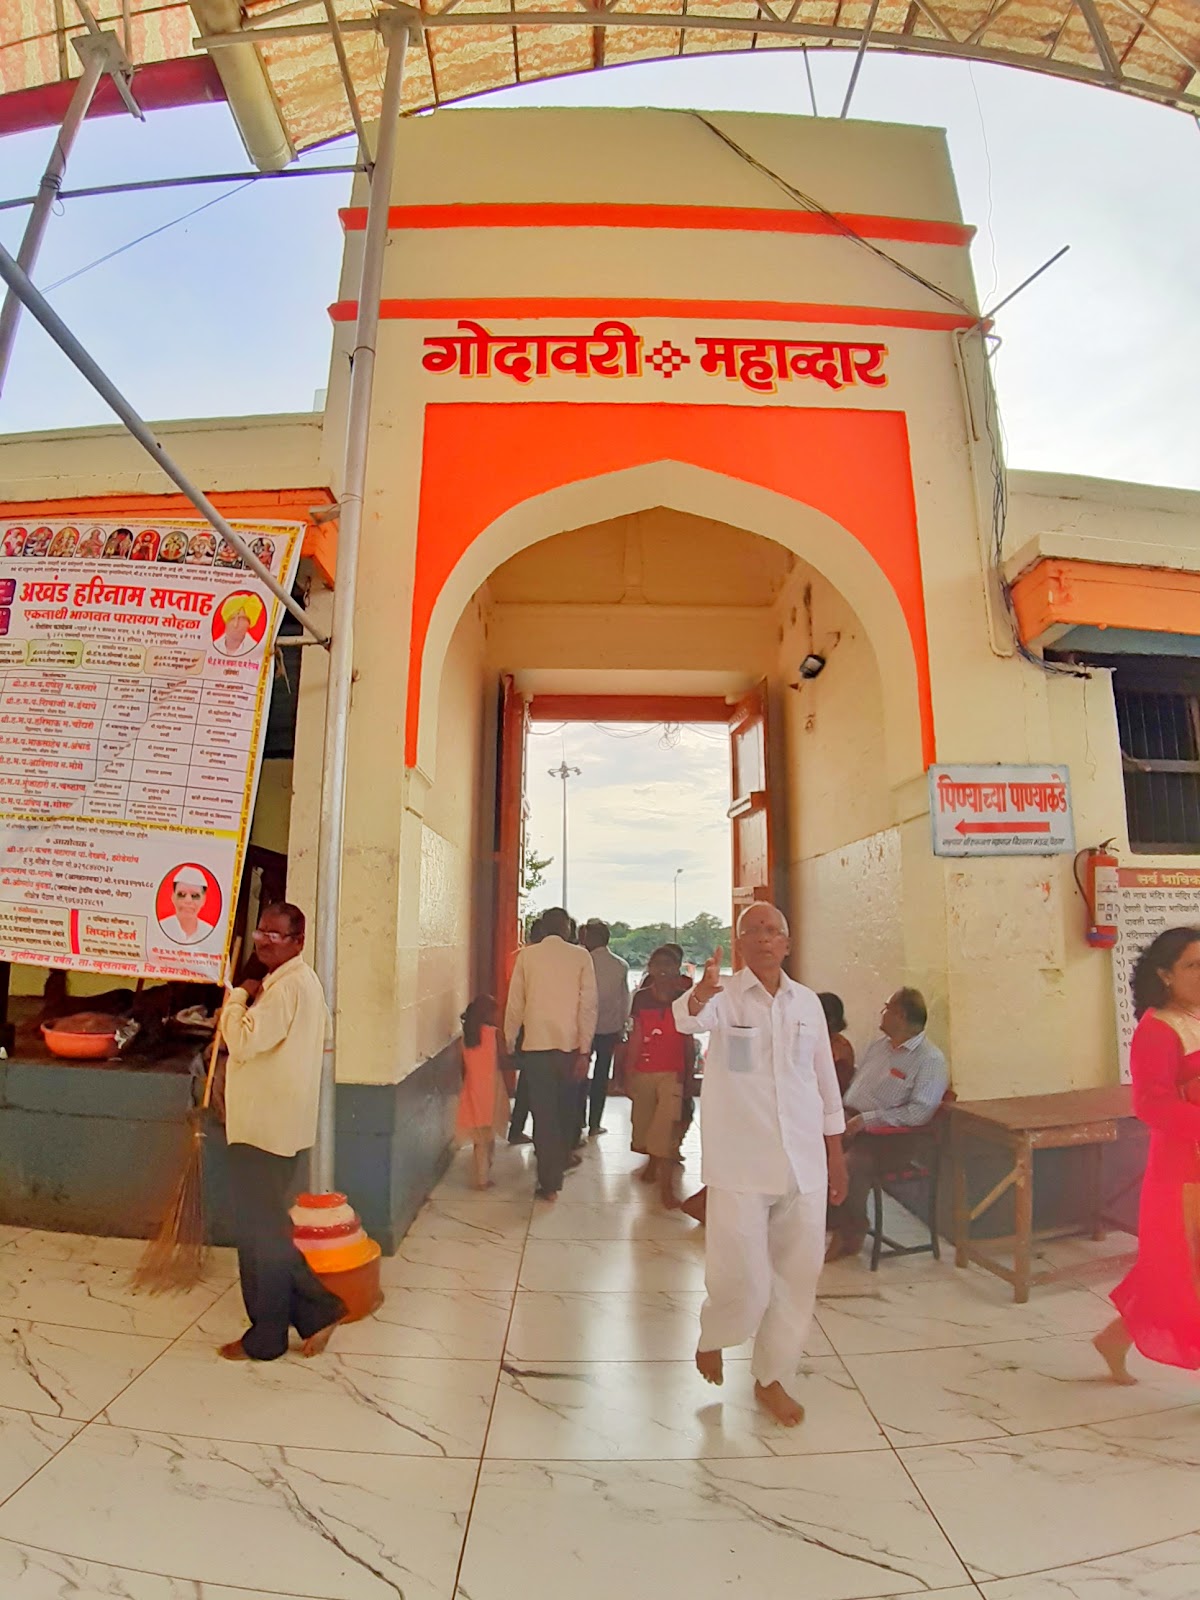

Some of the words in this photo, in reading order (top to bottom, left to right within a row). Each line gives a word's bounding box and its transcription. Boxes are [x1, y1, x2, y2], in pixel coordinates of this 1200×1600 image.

[421, 320, 642, 384] गोदावरी
[19, 574, 70, 603] अखंड
[73, 575, 146, 609] हरिनाम
[150, 588, 215, 616] सप्ताह
[23, 606, 68, 621] एकनाथी
[69, 609, 111, 622] भागवत
[113, 612, 159, 627] पारायण
[161, 613, 201, 631] सोहळा
[936, 774, 1007, 814] पिण्याच्या
[1008, 773, 1068, 814] पाण्याकडे
[1136, 871, 1158, 885] सर्व
